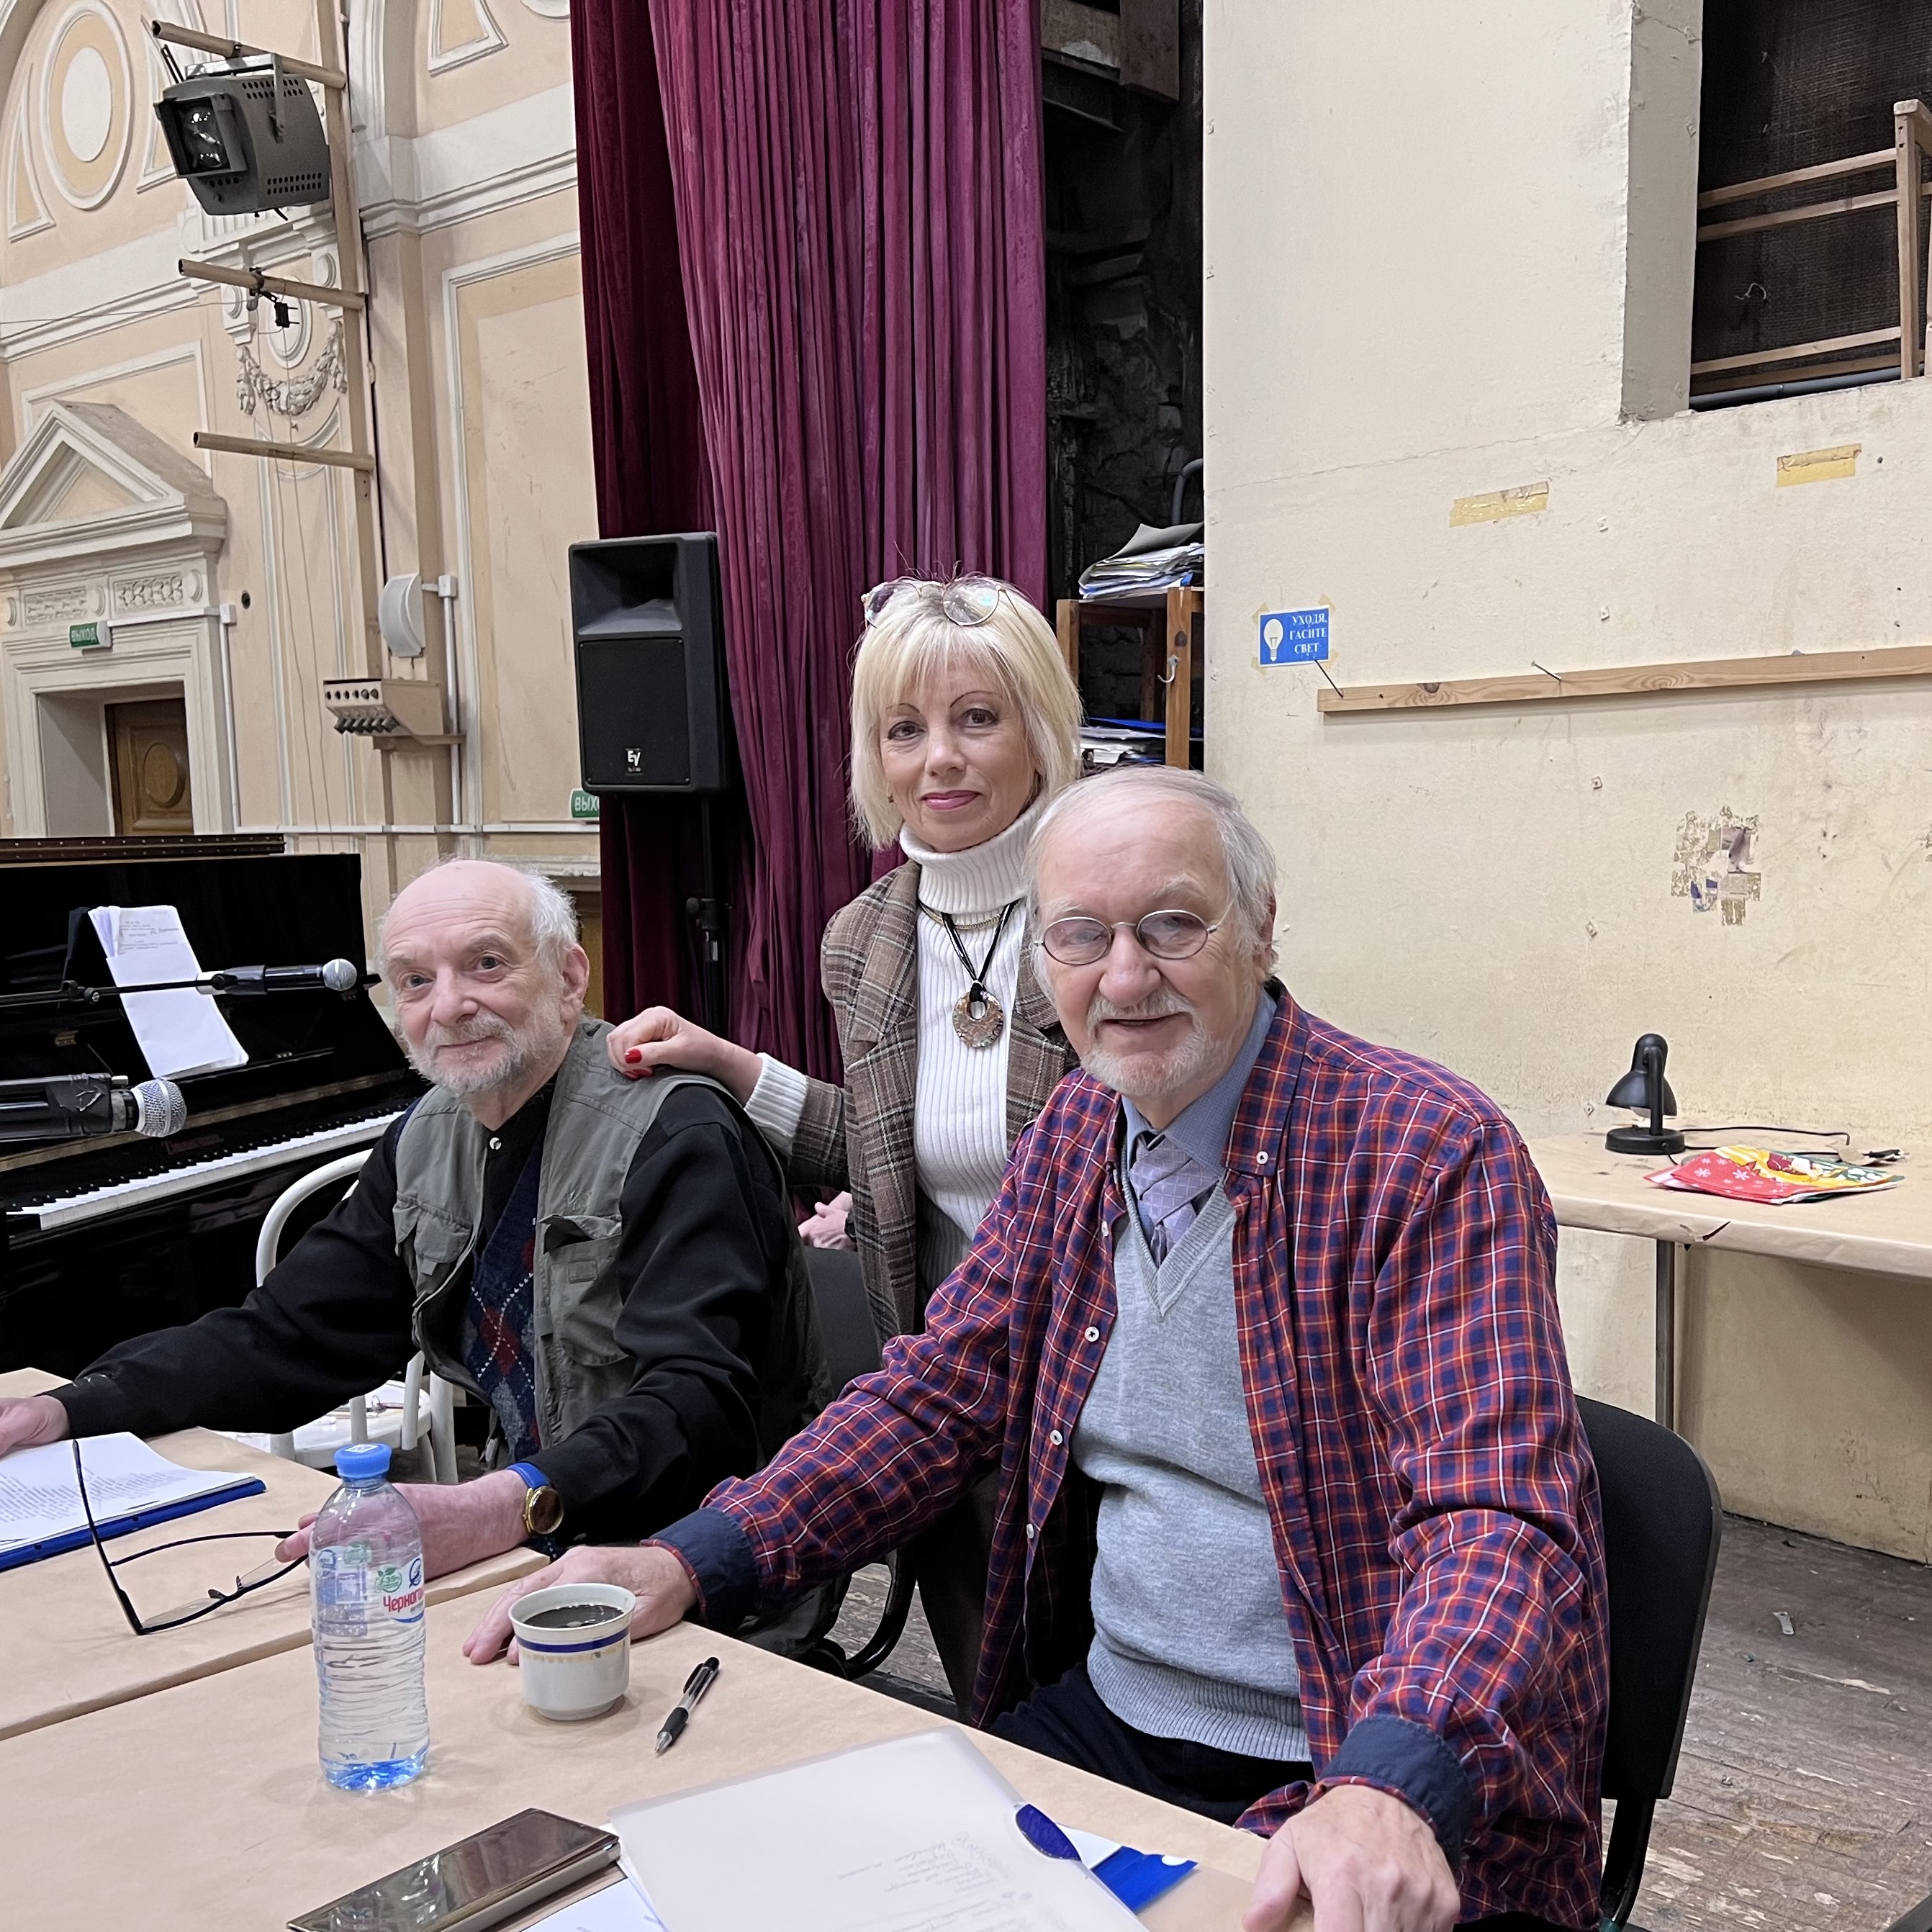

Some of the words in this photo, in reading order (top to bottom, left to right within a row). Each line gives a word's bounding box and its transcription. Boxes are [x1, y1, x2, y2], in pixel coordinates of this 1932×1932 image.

[71, 627, 98, 643] ВЫХОД
[1289, 628, 1327, 640] ГАСИТЕ
[1294, 642, 1319, 654] СВЕТ
